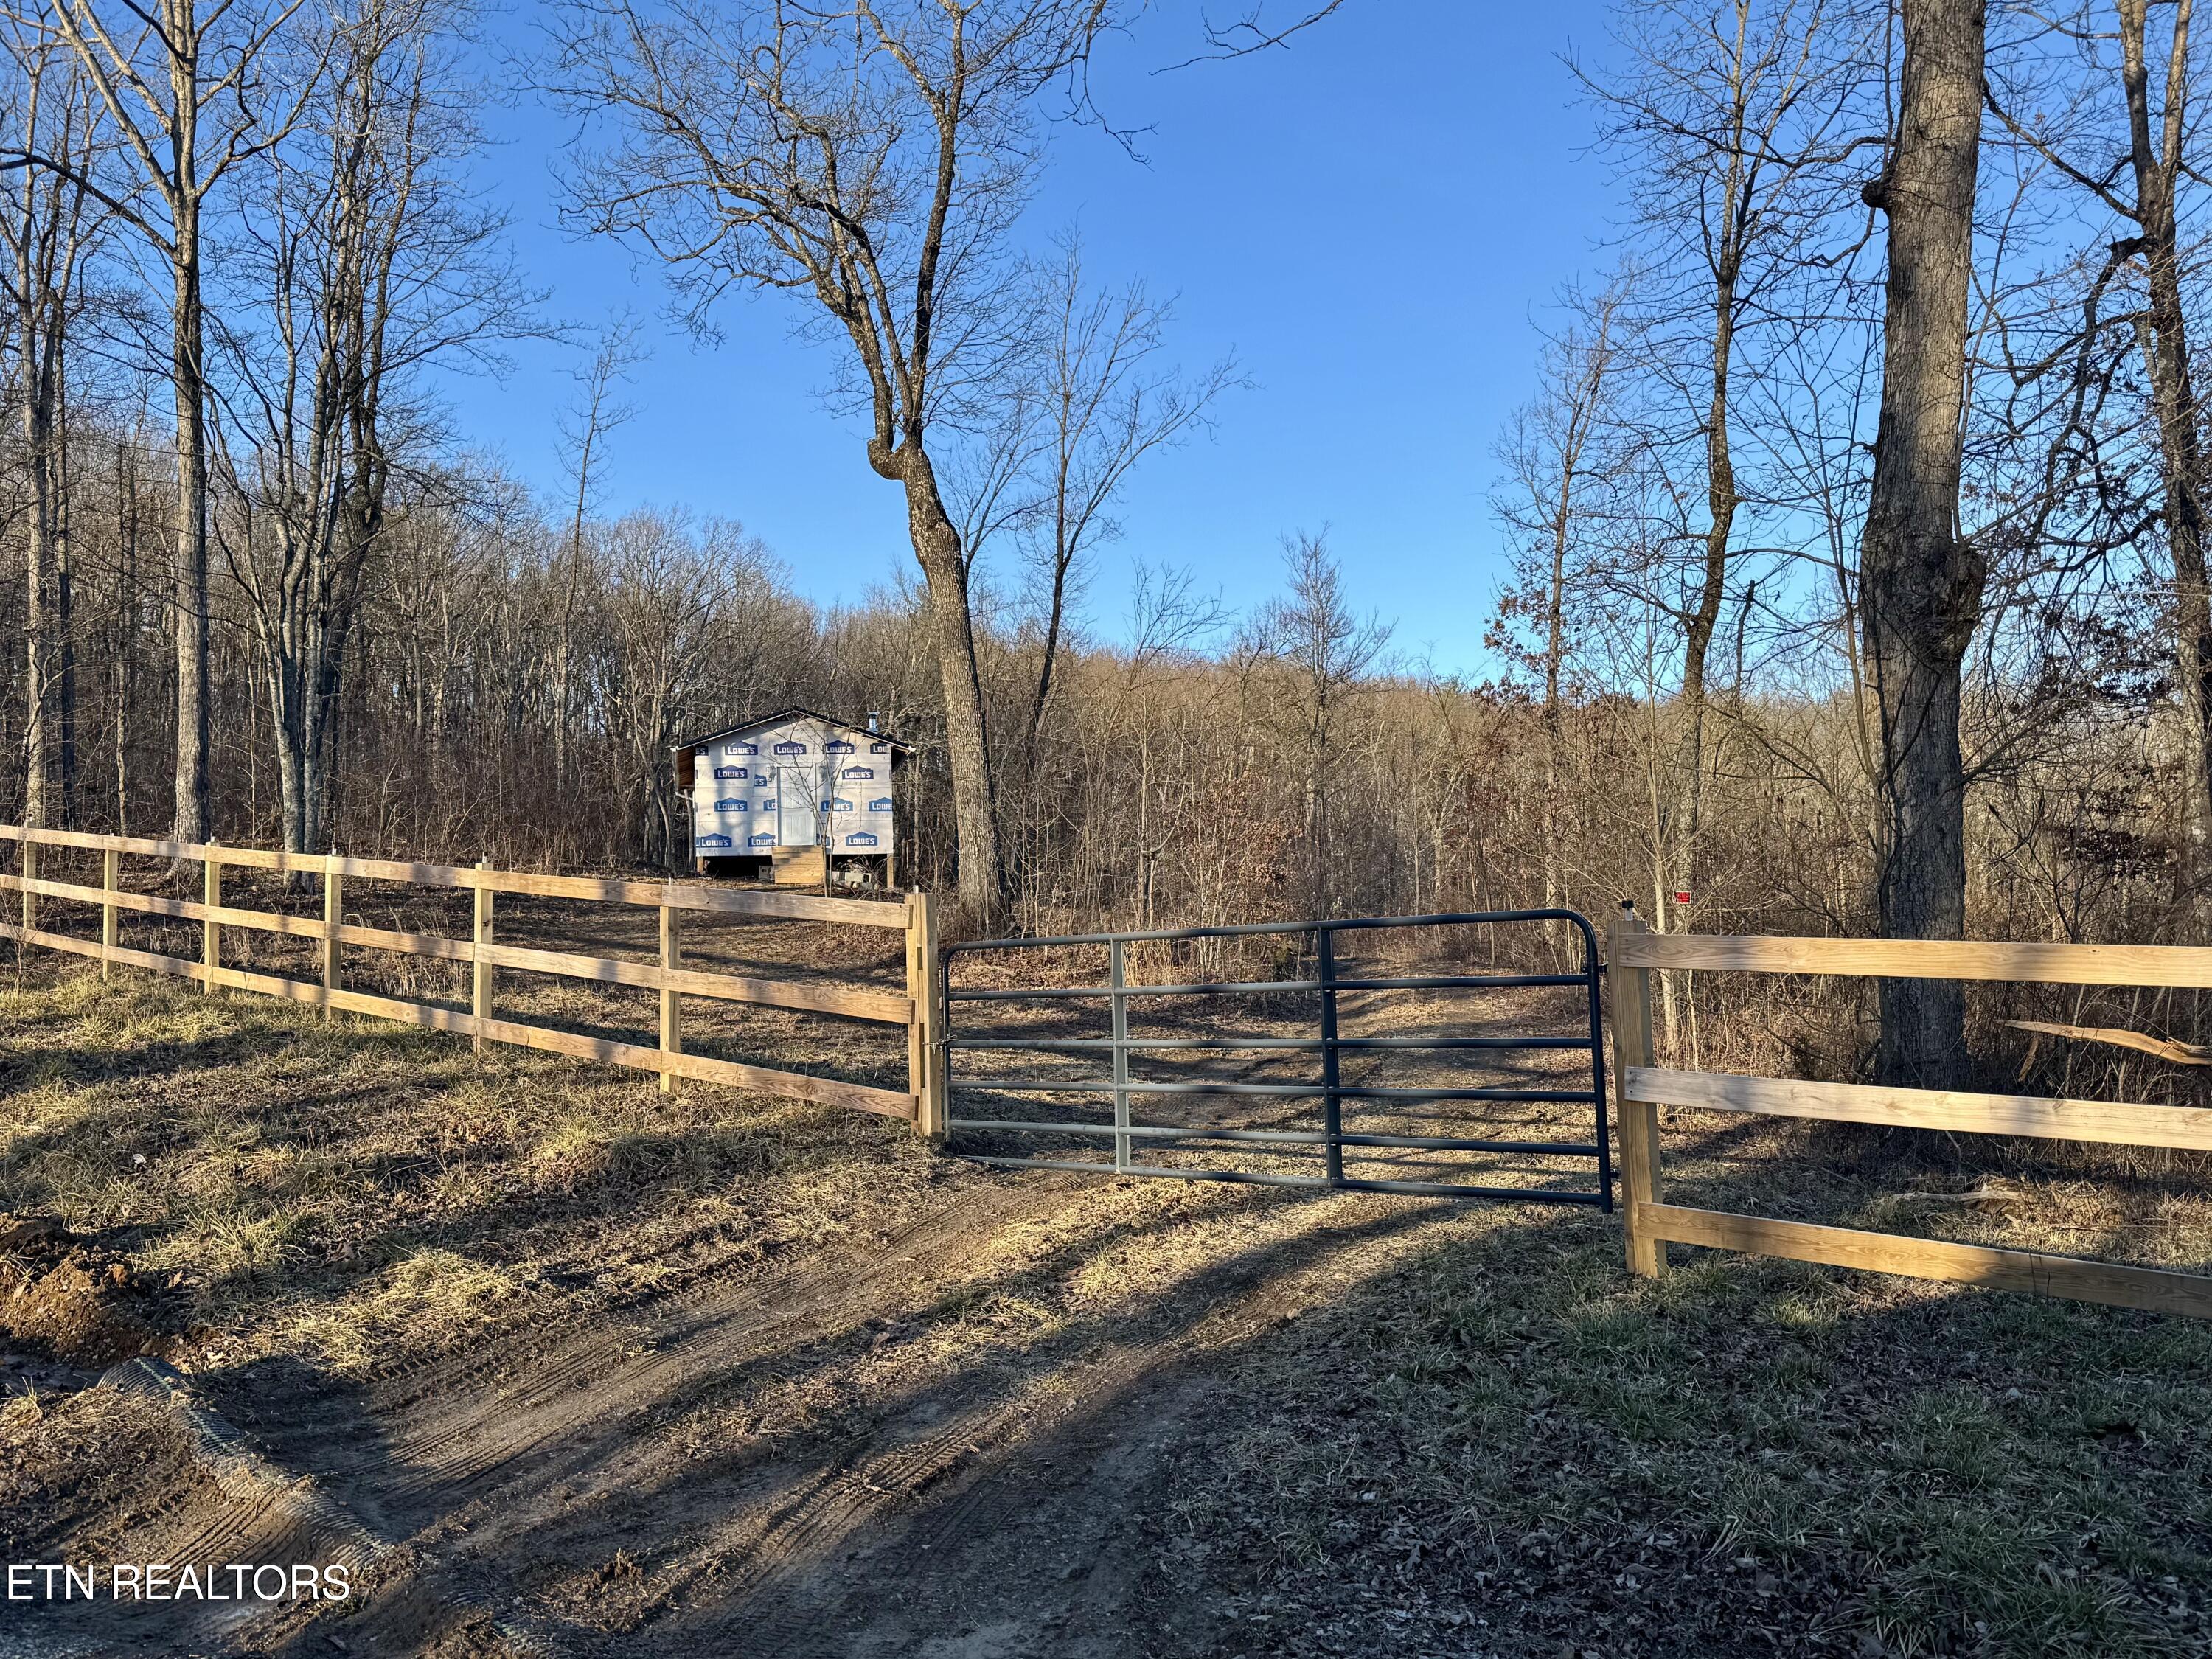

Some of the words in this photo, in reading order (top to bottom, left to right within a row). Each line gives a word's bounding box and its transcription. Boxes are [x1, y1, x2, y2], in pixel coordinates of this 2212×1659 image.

[728, 746, 755, 755] LOWE'S
[717, 770, 745, 778] LOWE'S
[845, 771, 871, 779] LOWE'S
[717, 802, 745, 810] LOWE'S
[824, 802, 849, 810] LWE'S
[701, 838, 728, 846] LOWE'S
[849, 837, 874, 845] LOWE'S
